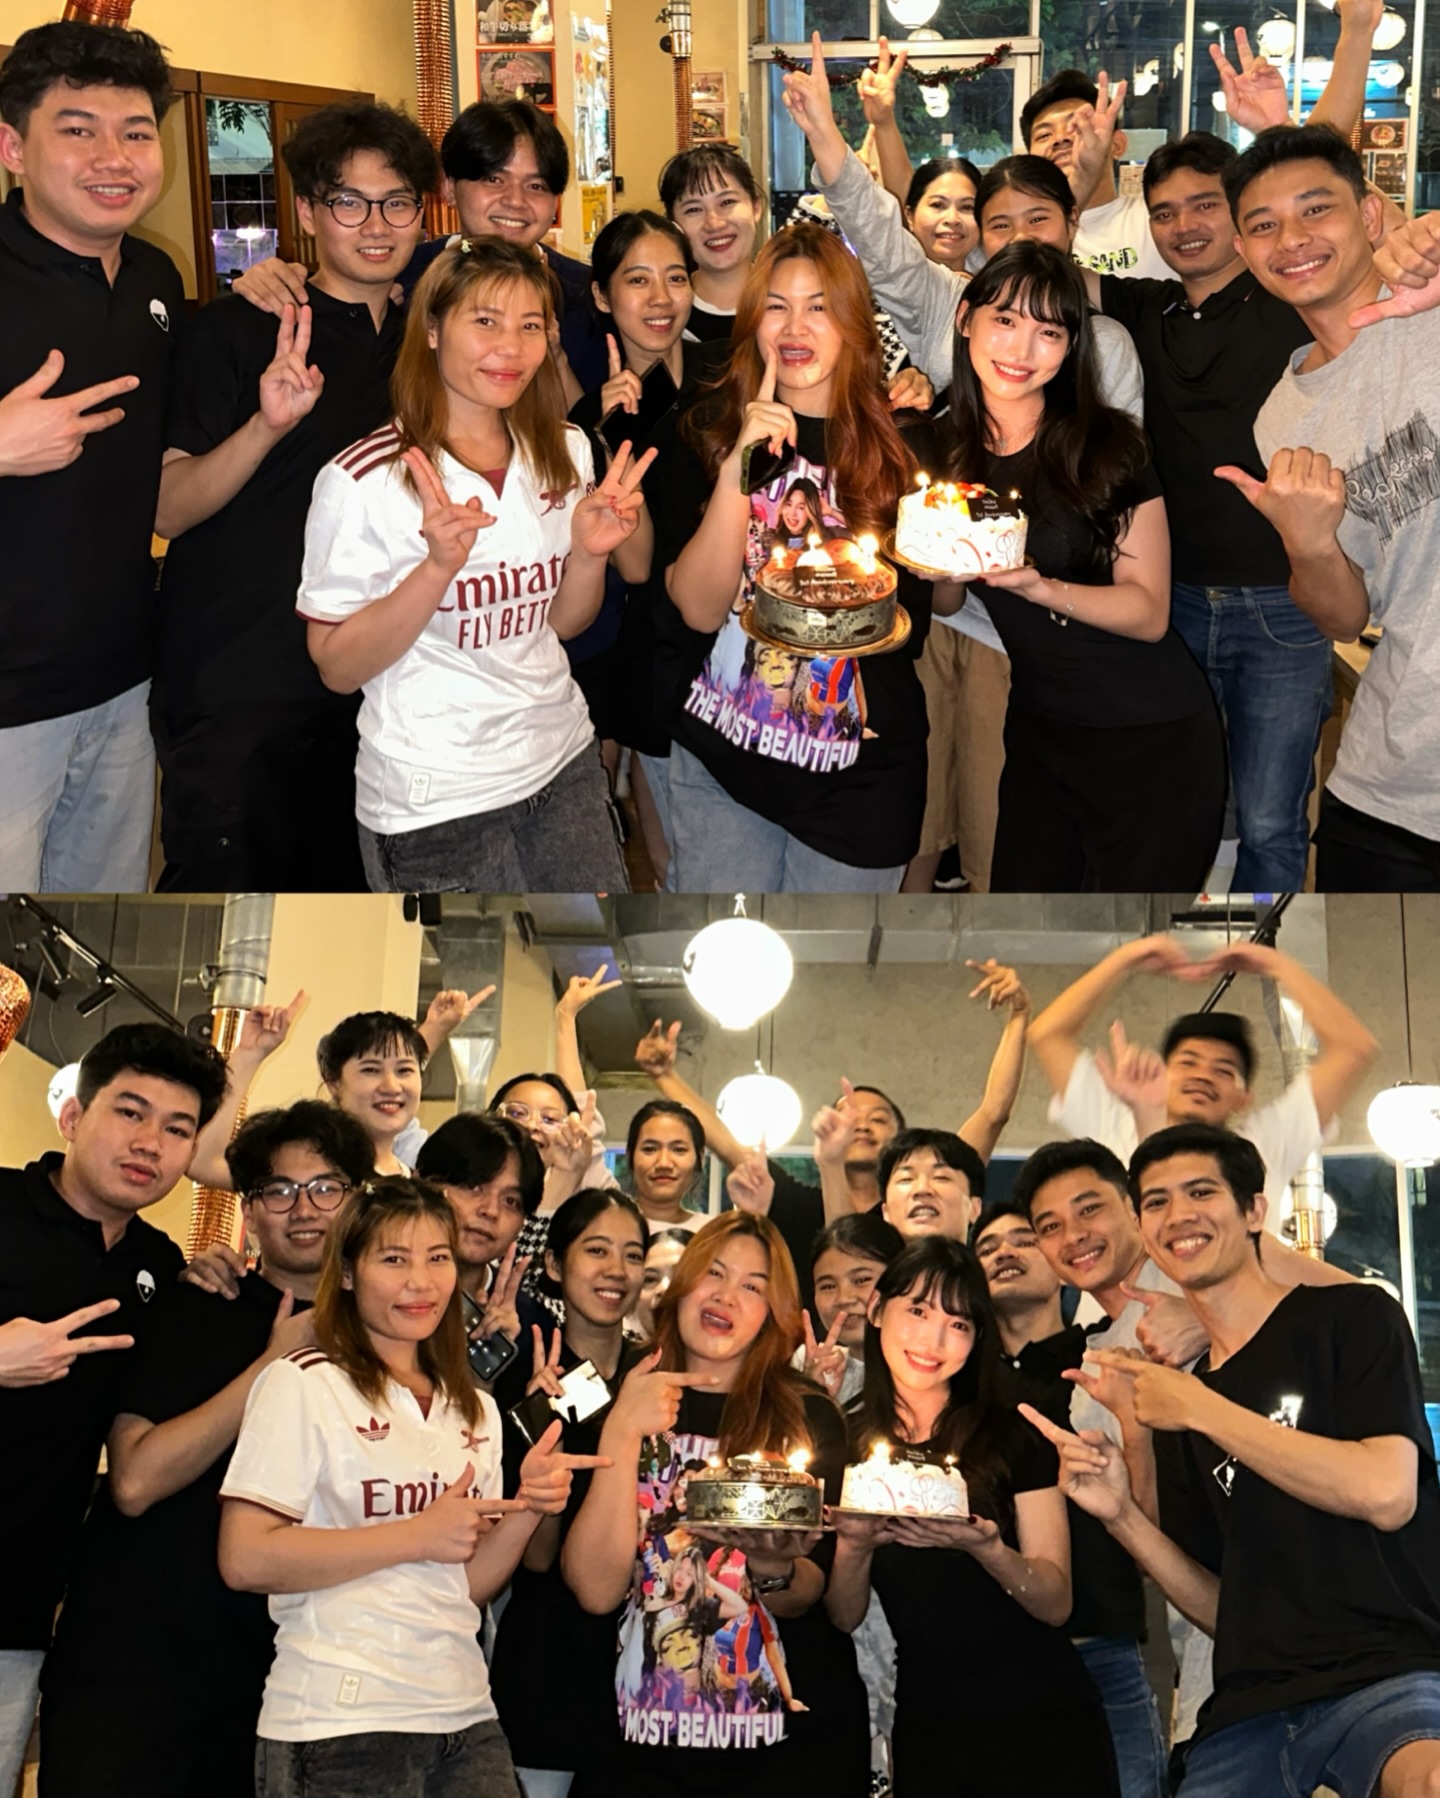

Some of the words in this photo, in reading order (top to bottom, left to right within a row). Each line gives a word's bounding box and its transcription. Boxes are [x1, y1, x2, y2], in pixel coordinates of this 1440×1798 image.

[436, 551, 572, 612] mirat
[458, 611, 492, 650] FLY
[498, 594, 557, 641] BETT
[683, 680, 721, 726] THE
[714, 700, 758, 751] MOST
[624, 1707, 674, 1746] MOST
[677, 1712, 789, 1749] BEAUTIFUL
